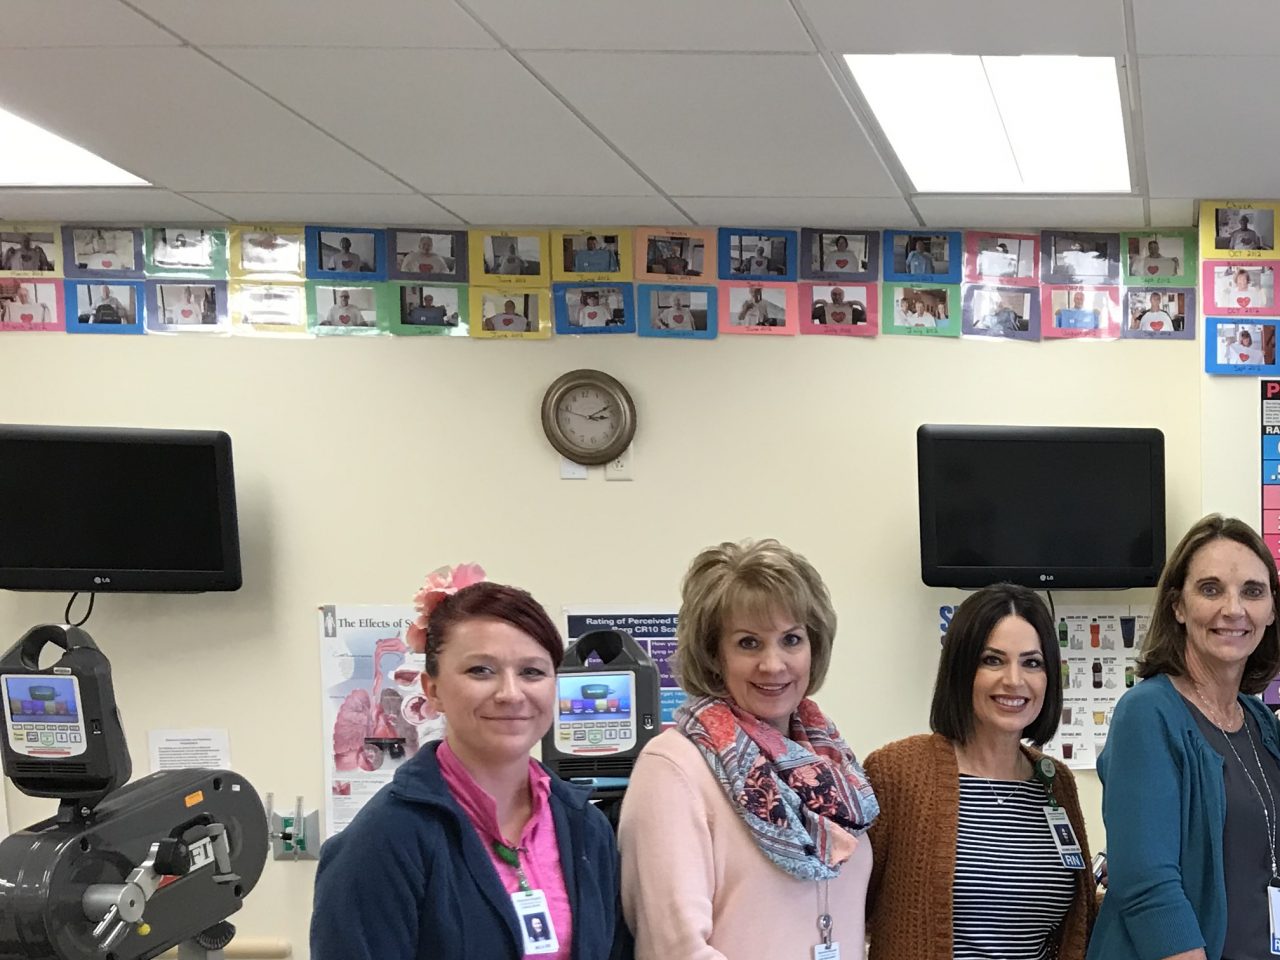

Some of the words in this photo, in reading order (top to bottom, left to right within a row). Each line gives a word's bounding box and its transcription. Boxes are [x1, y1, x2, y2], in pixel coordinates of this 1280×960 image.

[338, 618, 357, 628] The
[359, 618, 390, 628] Effects
[393, 618, 404, 628] of
[586, 617, 615, 627] Rating
[617, 617, 627, 626] of
[628, 617, 672, 625] Perceived
[634, 625, 659, 633] CR10
[661, 625, 677, 633] Sca
[189, 840, 212, 867] FI
[1065, 854, 1081, 867] RN
